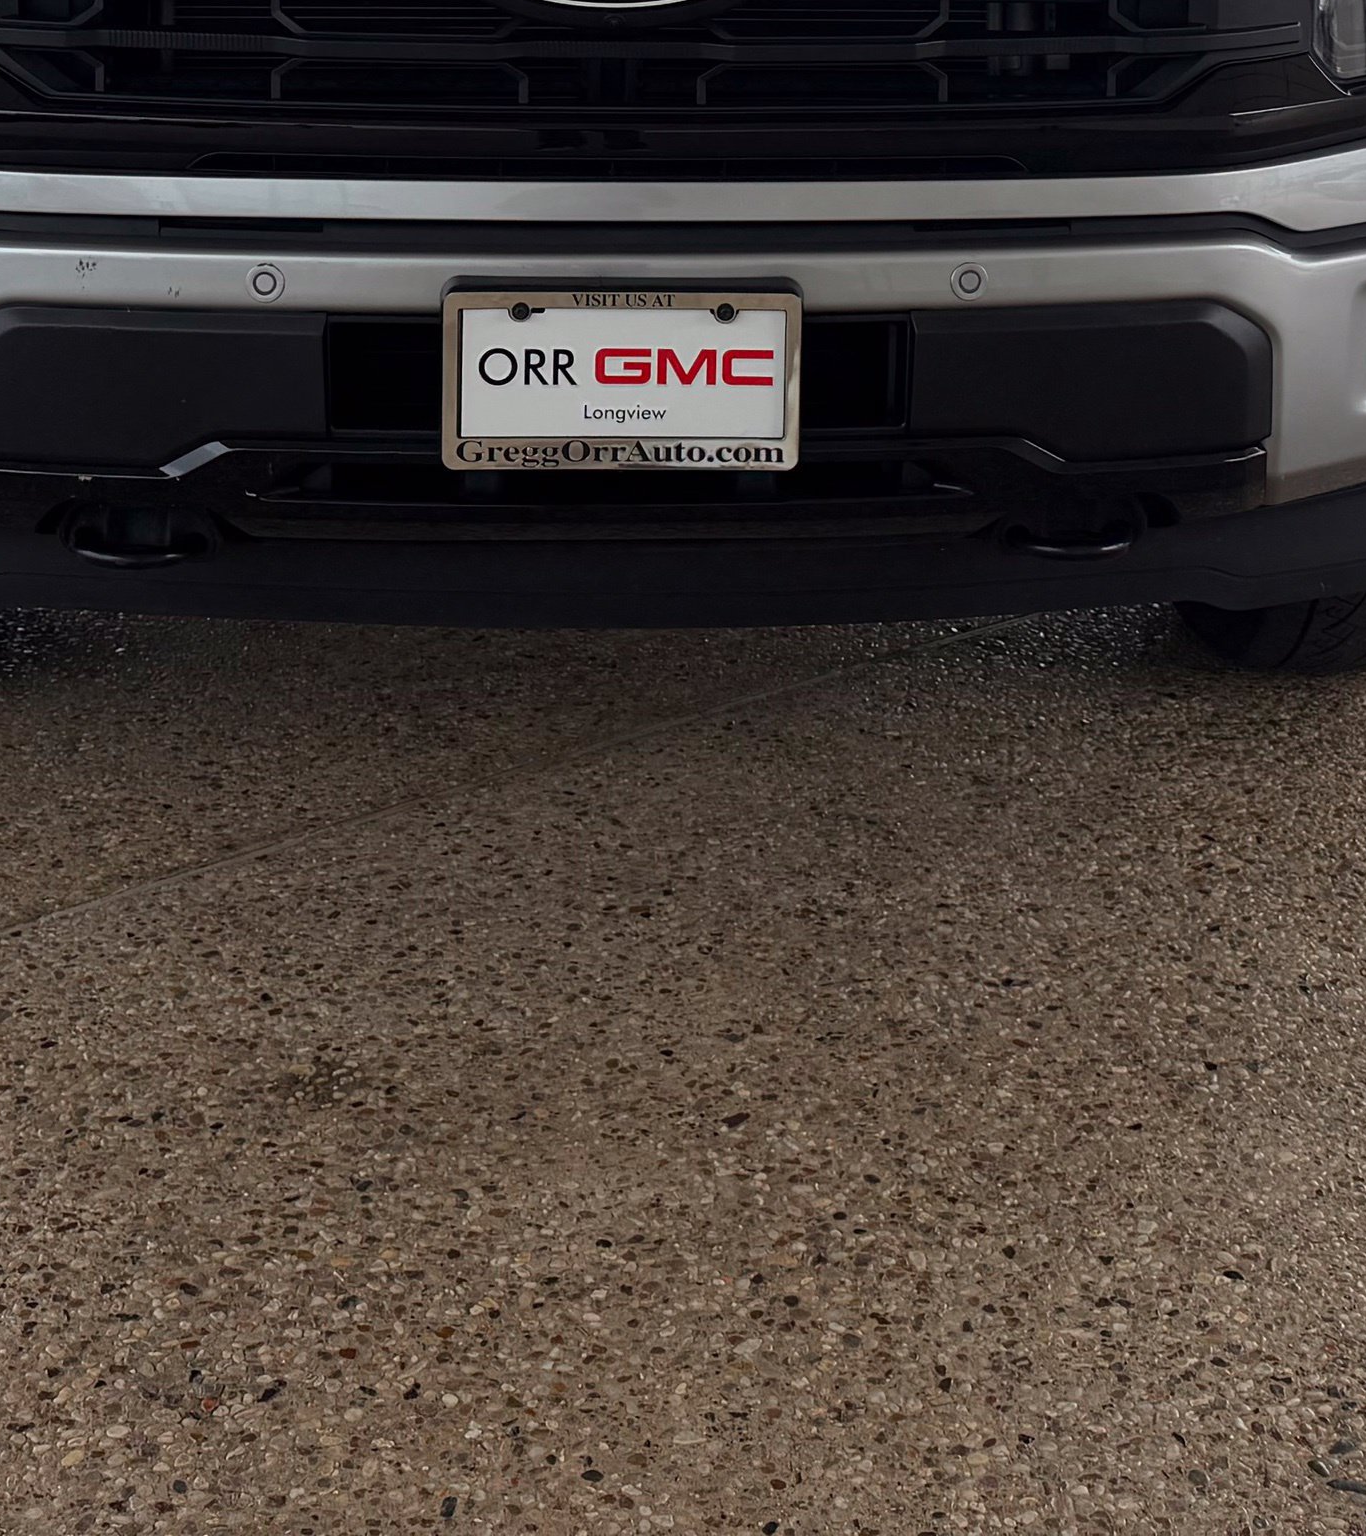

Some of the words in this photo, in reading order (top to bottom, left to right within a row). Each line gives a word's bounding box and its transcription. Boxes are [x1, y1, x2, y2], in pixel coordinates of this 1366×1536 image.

[572, 293, 620, 308] VISIT
[625, 293, 648, 308] US
[652, 293, 676, 308] AT
[478, 347, 578, 387] ORR
[594, 348, 775, 387] GMC
[583, 405, 667, 424] Longview
[456, 439, 785, 468] GreggOrrAuto.com
